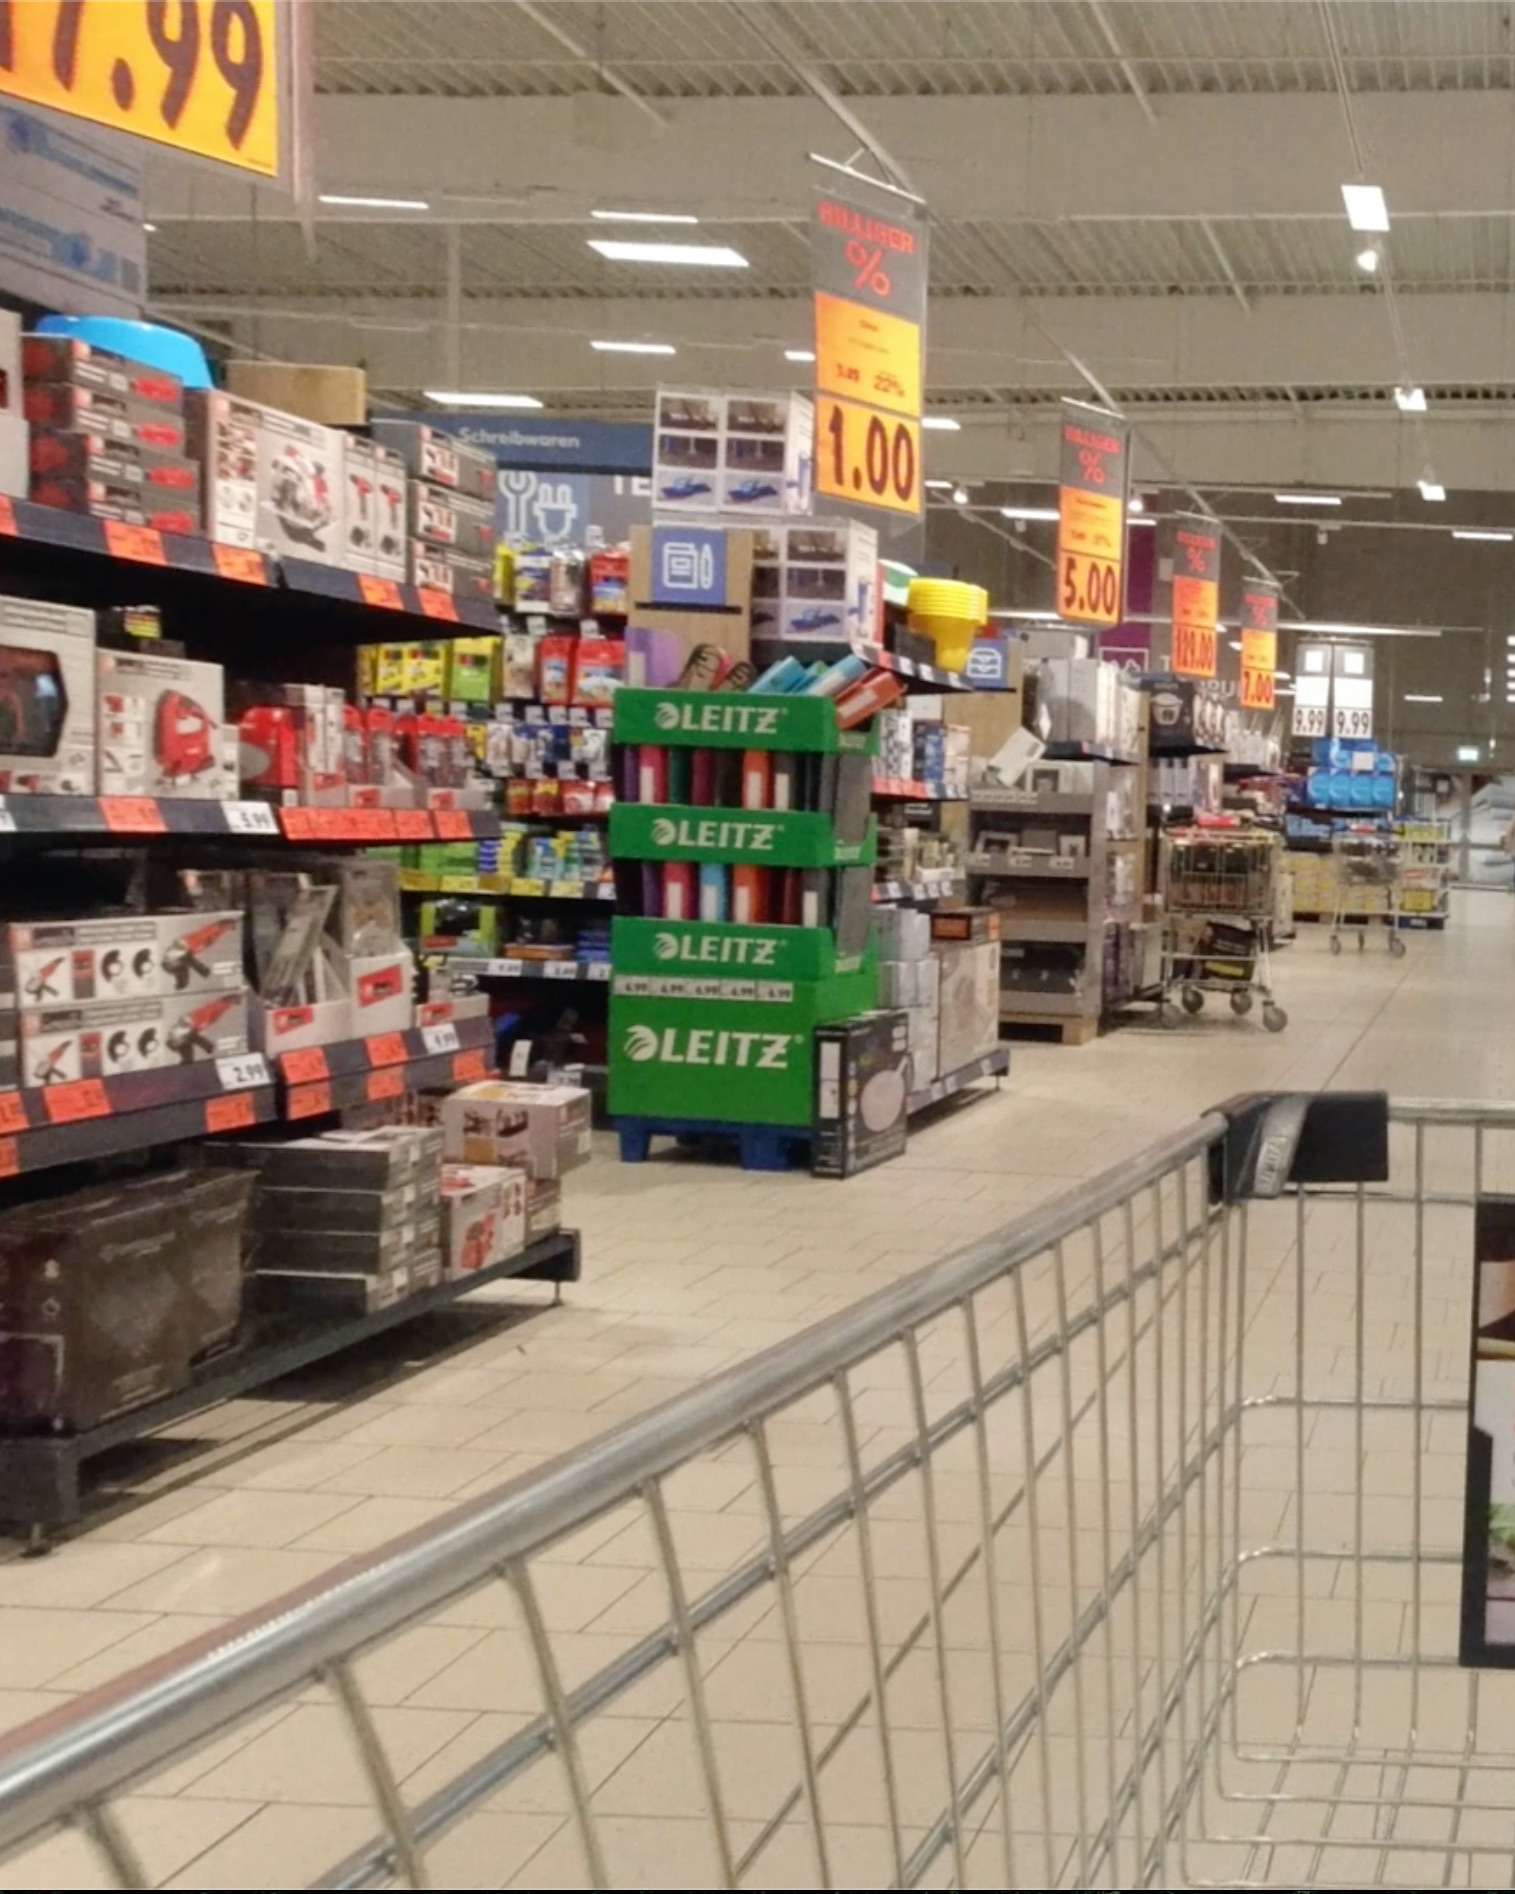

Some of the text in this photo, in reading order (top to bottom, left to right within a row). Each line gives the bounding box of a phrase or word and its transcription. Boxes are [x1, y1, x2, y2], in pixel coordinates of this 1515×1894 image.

[458, 427, 580, 448] Schreibwaren
[828, 403, 914, 503] 1.00
[1064, 556, 1117, 616] 5.00
[680, 705, 778, 735] LEITZ
[1336, 711, 1370, 735] 9.99
[677, 820, 774, 851] LEITZ
[680, 936, 777, 966] LEITZ
[659, 1030, 790, 1069] LEITZ
[233, 1063, 265, 1083] 2.99
